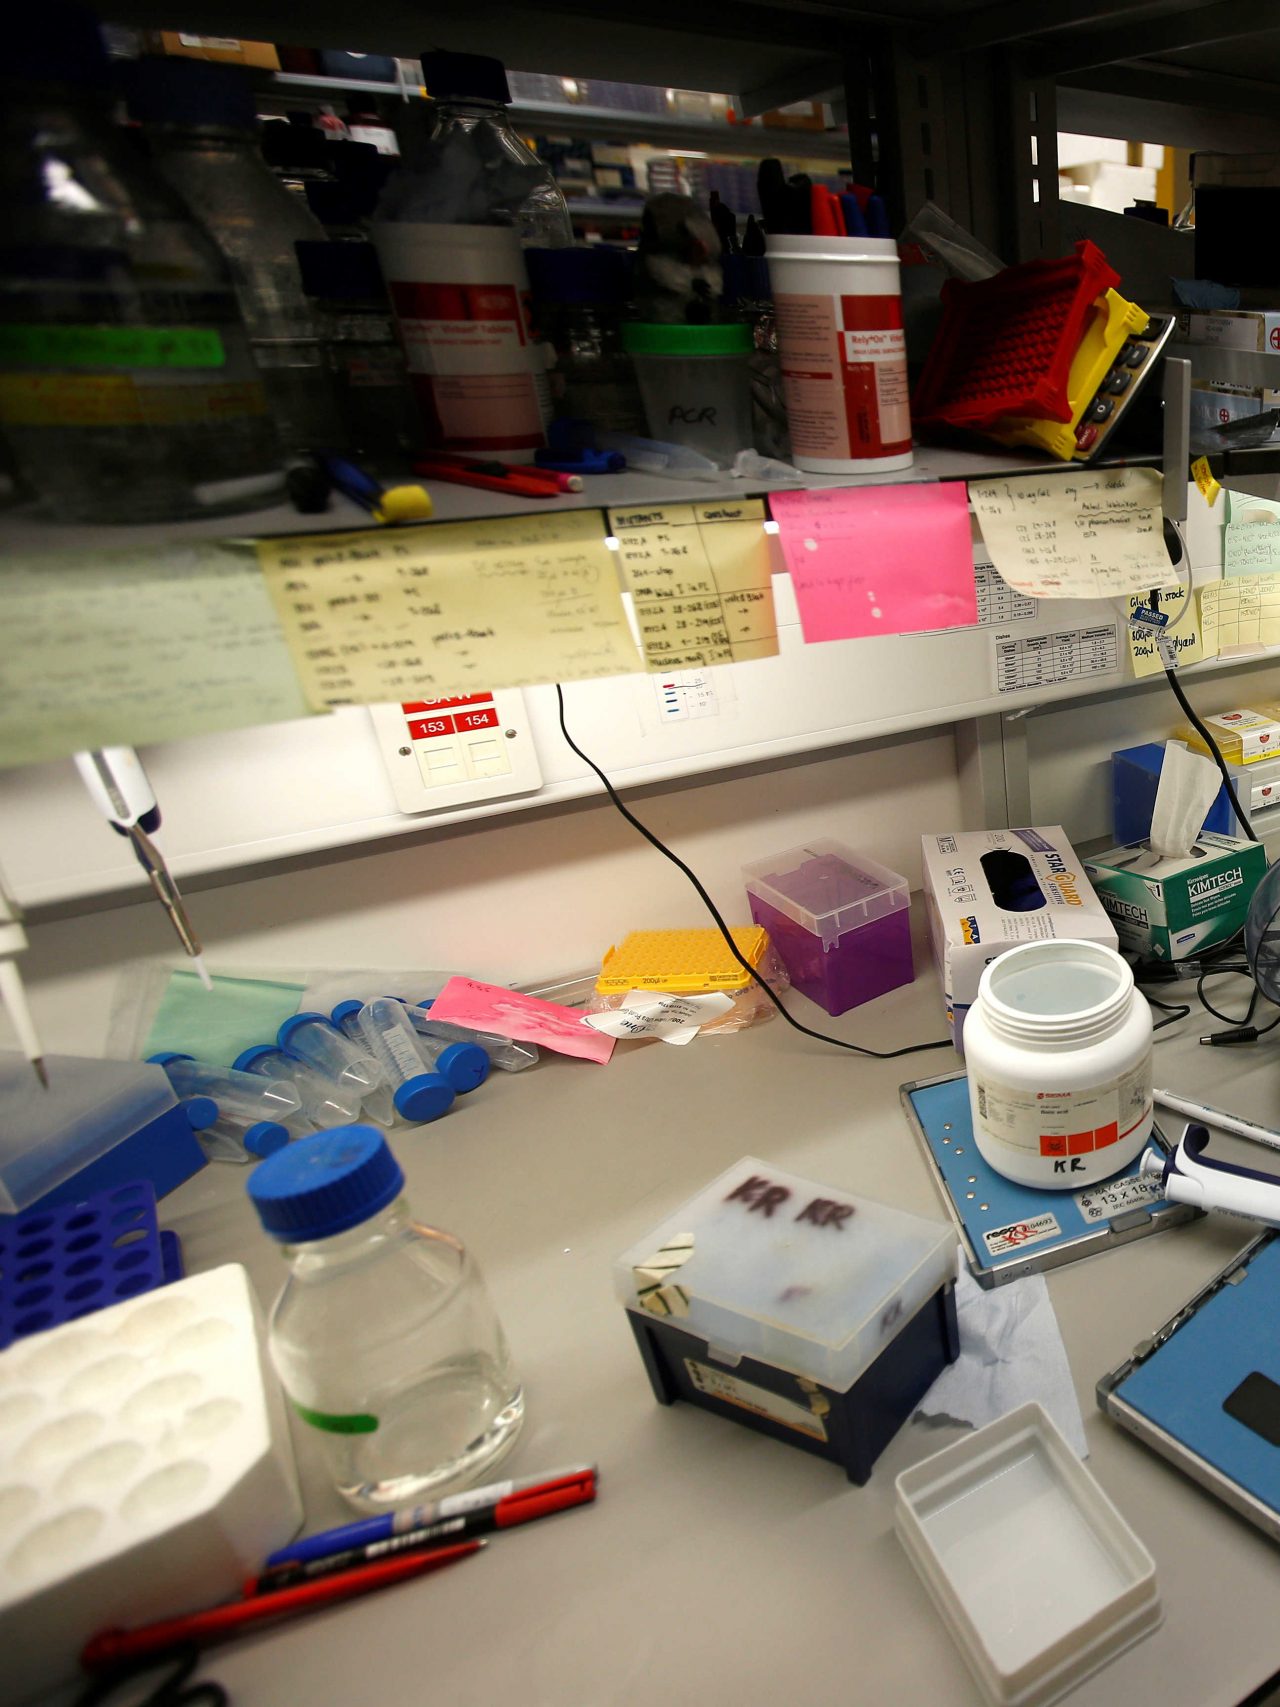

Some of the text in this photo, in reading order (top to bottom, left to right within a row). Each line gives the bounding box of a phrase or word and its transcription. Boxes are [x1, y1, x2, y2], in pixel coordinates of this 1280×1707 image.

[668, 404, 717, 426] PCR
[1140, 609, 1164, 621] PASSED
[420, 714, 489, 733] 153 154
[1188, 866, 1243, 897] KIMTECH
[1101, 895, 1148, 922] KIMTECH
[642, 977, 661, 985] 200µl
[1054, 1157, 1086, 1173] KR
[723, 1175, 793, 1218] KR
[1101, 1194, 1118, 1206] 13
[1132, 1183, 1148, 1195] 18
